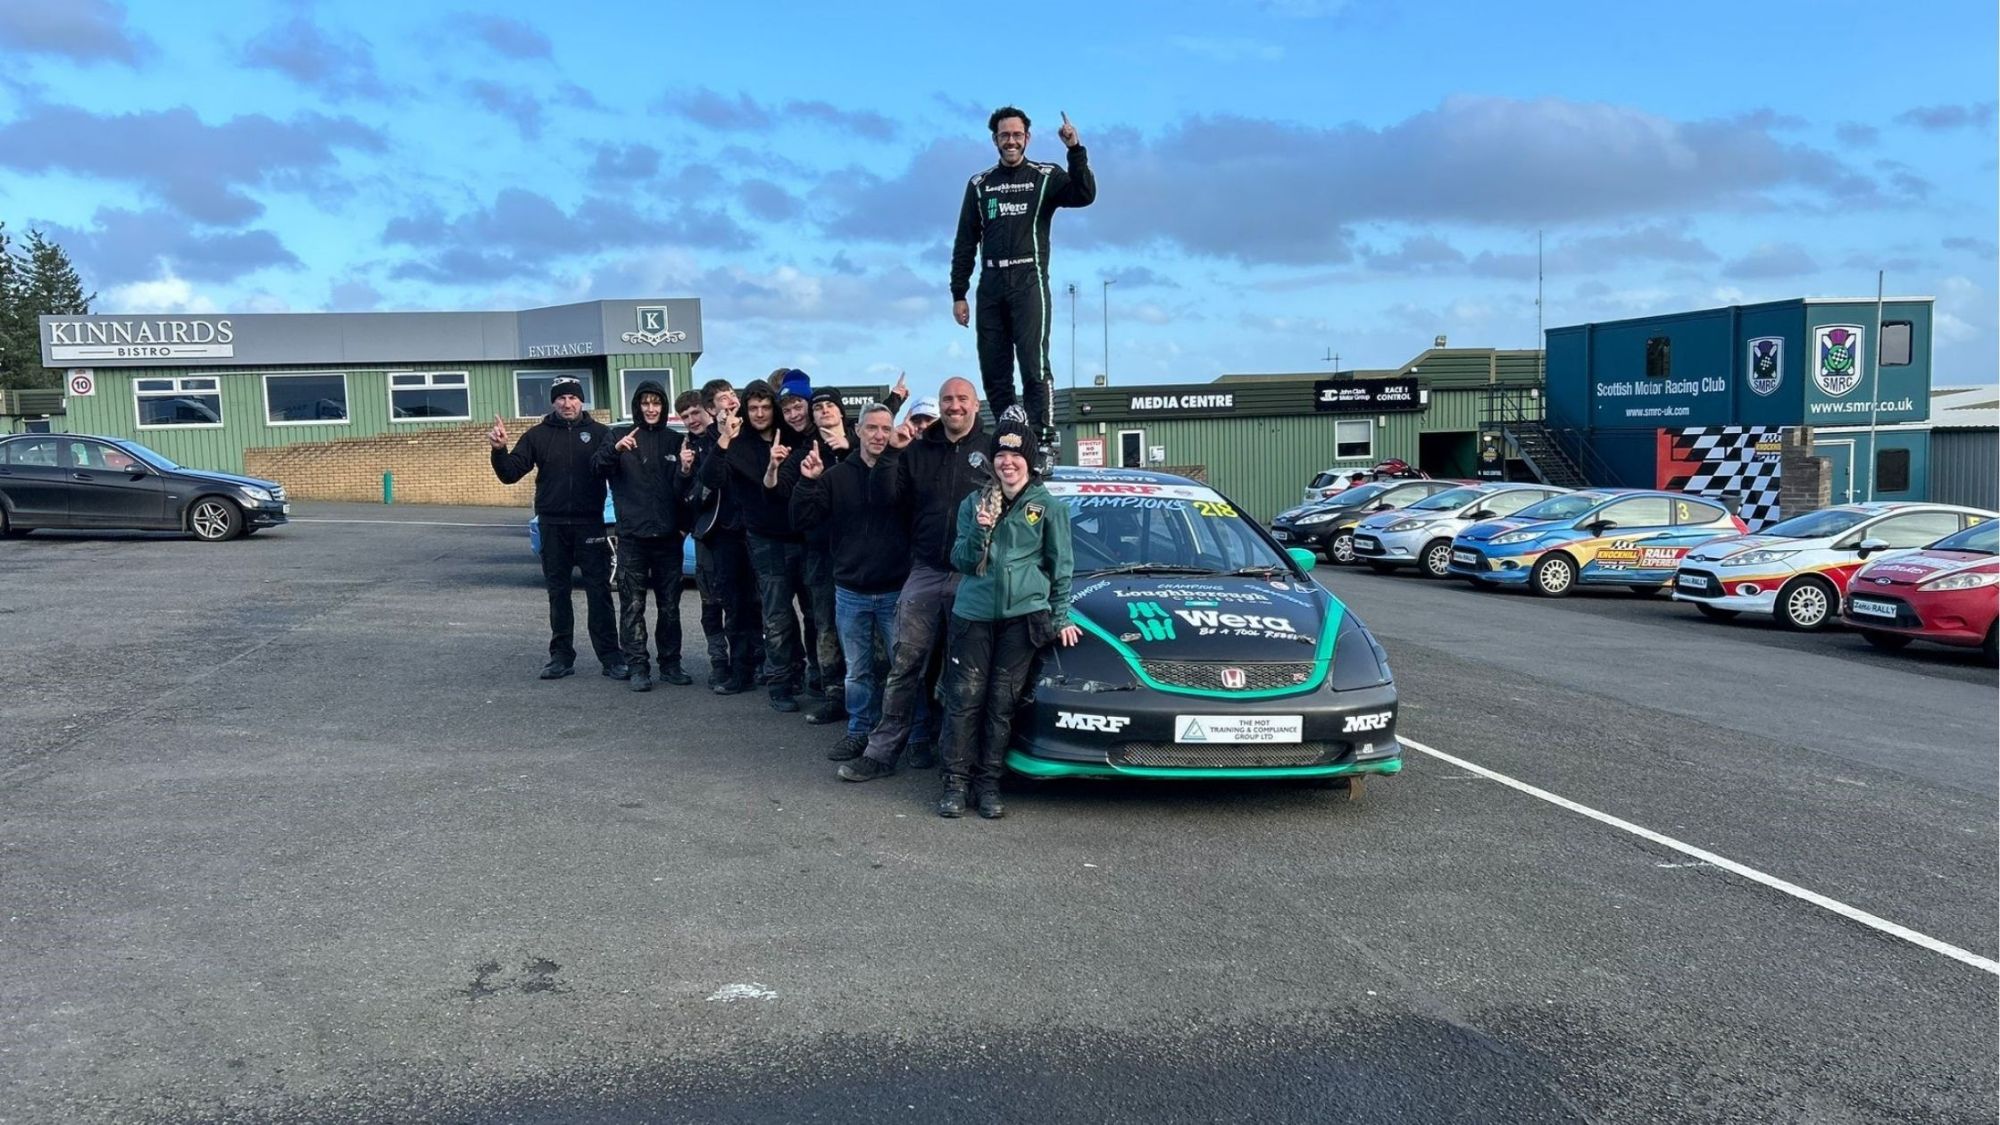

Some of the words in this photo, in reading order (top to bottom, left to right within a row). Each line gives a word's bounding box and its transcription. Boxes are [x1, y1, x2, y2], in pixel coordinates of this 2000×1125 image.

[999, 202, 1028, 212] Wera
[646, 312, 659, 329] K
[49, 320, 233, 345] KINNAIRDS
[118, 347, 171, 357] BISTRO
[529, 342, 593, 357] ENTRANCE
[75, 380, 88, 390] 10
[1384, 386, 1403, 394] RACE
[1597, 382, 1632, 396] Scottish
[1635, 381, 1662, 395] Motor
[1665, 379, 1699, 396] Racing
[1702, 376, 1726, 393] Club
[1754, 379, 1776, 392] SMRC
[1823, 376, 1853, 392] SMRC
[841, 396, 874, 405] GENTS
[1131, 396, 1179, 410] MEDIA
[1180, 394, 1233, 408] CENTRE
[1376, 393, 1411, 401] CONTROL
[1625, 405, 1690, 417] www.smrc-uk.com
[1076, 484, 1162, 495] MRF
[1193, 502, 1238, 518] 218
[1679, 503, 1689, 520] 3
[1597, 550, 1637, 559] KNOCKHILL
[1645, 548, 1679, 559] RALLY
[1642, 559, 1678, 567] EXPERIEN
[1113, 589, 1269, 601] Loughborough
[1872, 603, 1896, 614] RALLY
[1174, 609, 1296, 633] Wera
[1055, 711, 1130, 733] MRF
[1342, 711, 1392, 733] MRF
